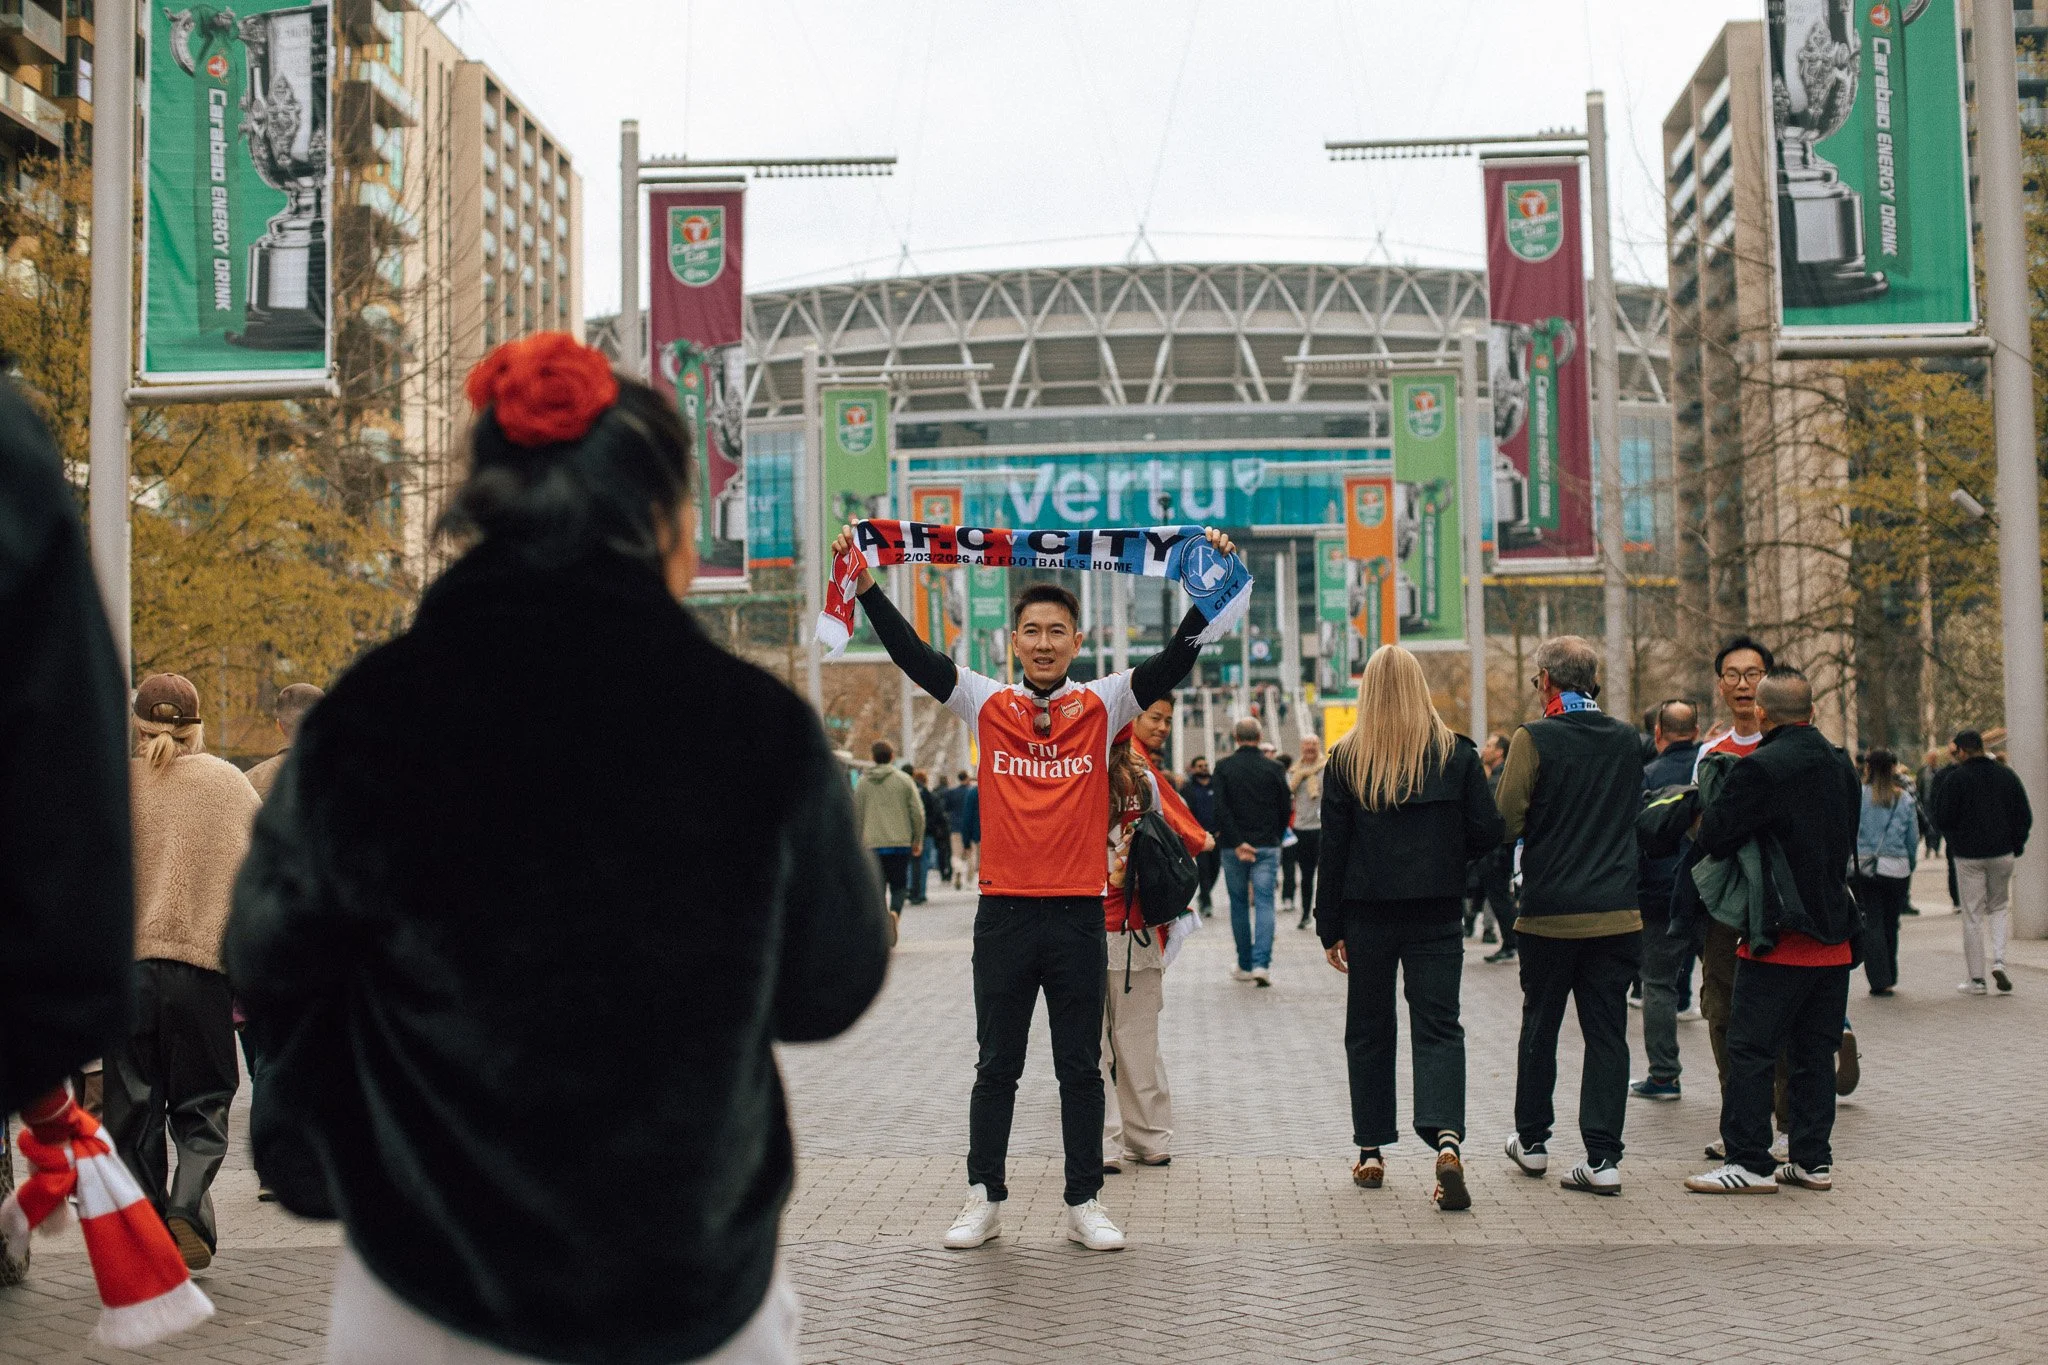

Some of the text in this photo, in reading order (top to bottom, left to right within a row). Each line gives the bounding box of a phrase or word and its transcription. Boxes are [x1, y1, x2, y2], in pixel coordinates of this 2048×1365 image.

[1872, 36, 1897, 256] Carabao ENERGY DRINK
[209, 87, 231, 311] Carabao ENERGY DRINK
[999, 460, 1226, 524] vertu
[856, 520, 994, 552] A.F.C
[1028, 529, 1186, 562] CITY
[895, 552, 1132, 572] 22/03/2026 AT FOOTBALL'S HOME
[1214, 580, 1239, 611] CITY
[993, 750, 1092, 778] Emirates
[1028, 742, 1058, 759] Fly
